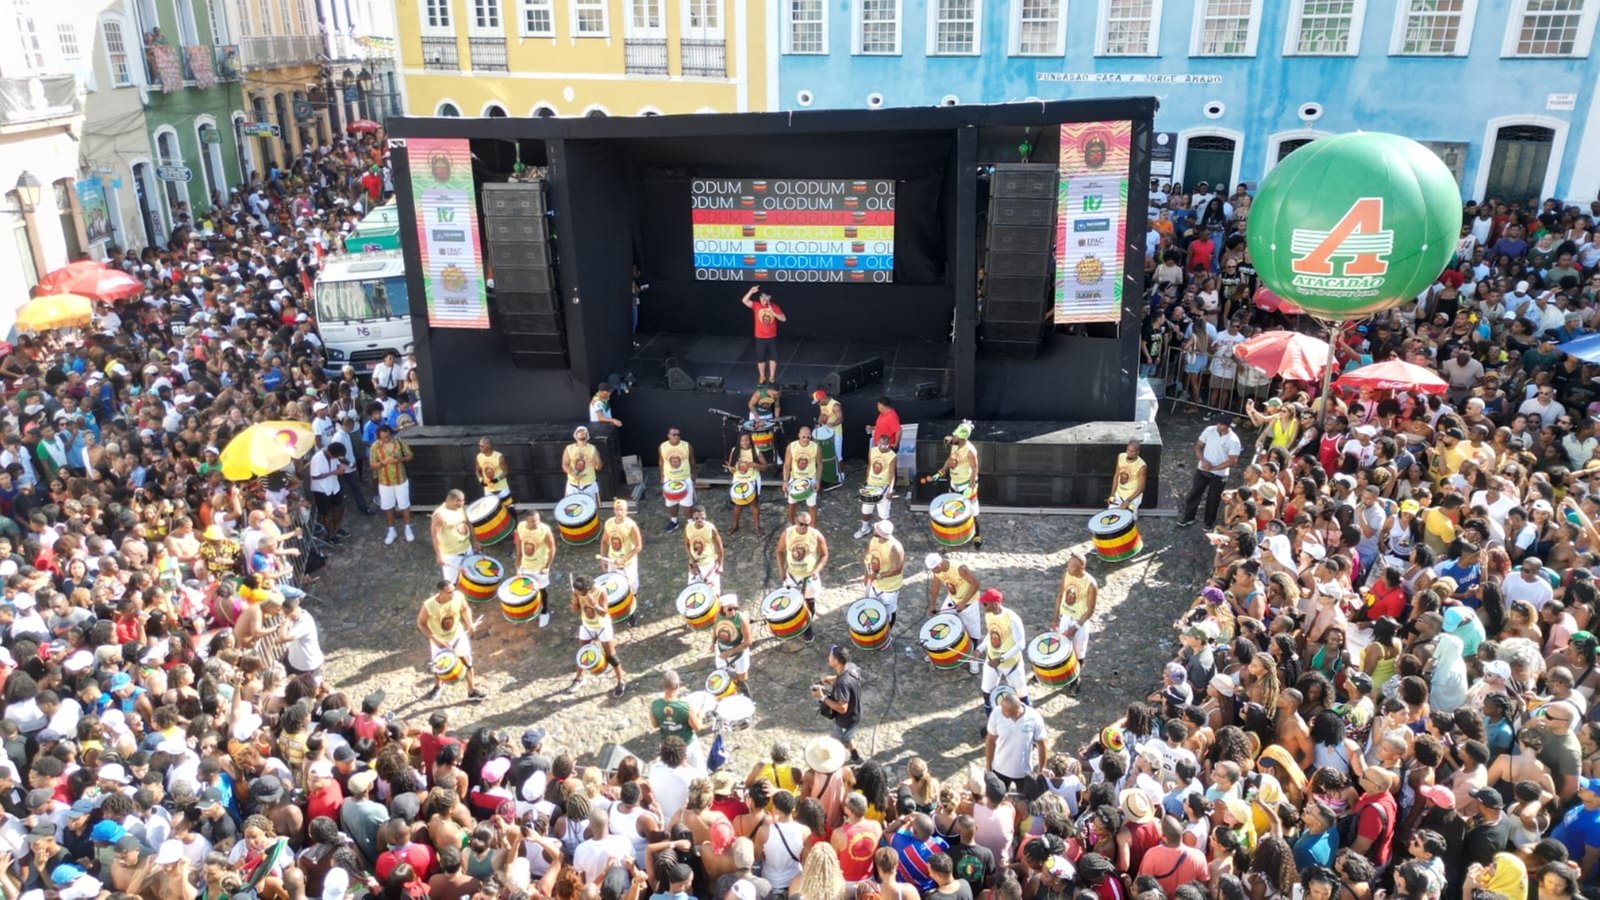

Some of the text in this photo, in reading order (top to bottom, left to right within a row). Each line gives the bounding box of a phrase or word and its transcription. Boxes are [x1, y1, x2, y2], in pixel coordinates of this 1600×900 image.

[692, 181, 742, 194] ODUM
[774, 181, 845, 195] OLODUM
[763, 197, 833, 210] OLODUM
[763, 226, 833, 240] OLODUM
[775, 241, 844, 254] OLODUM
[764, 255, 833, 269] OLODUM
[775, 269, 844, 282] OLODUM
[1293, 275, 1385, 290] ATACADÃO
